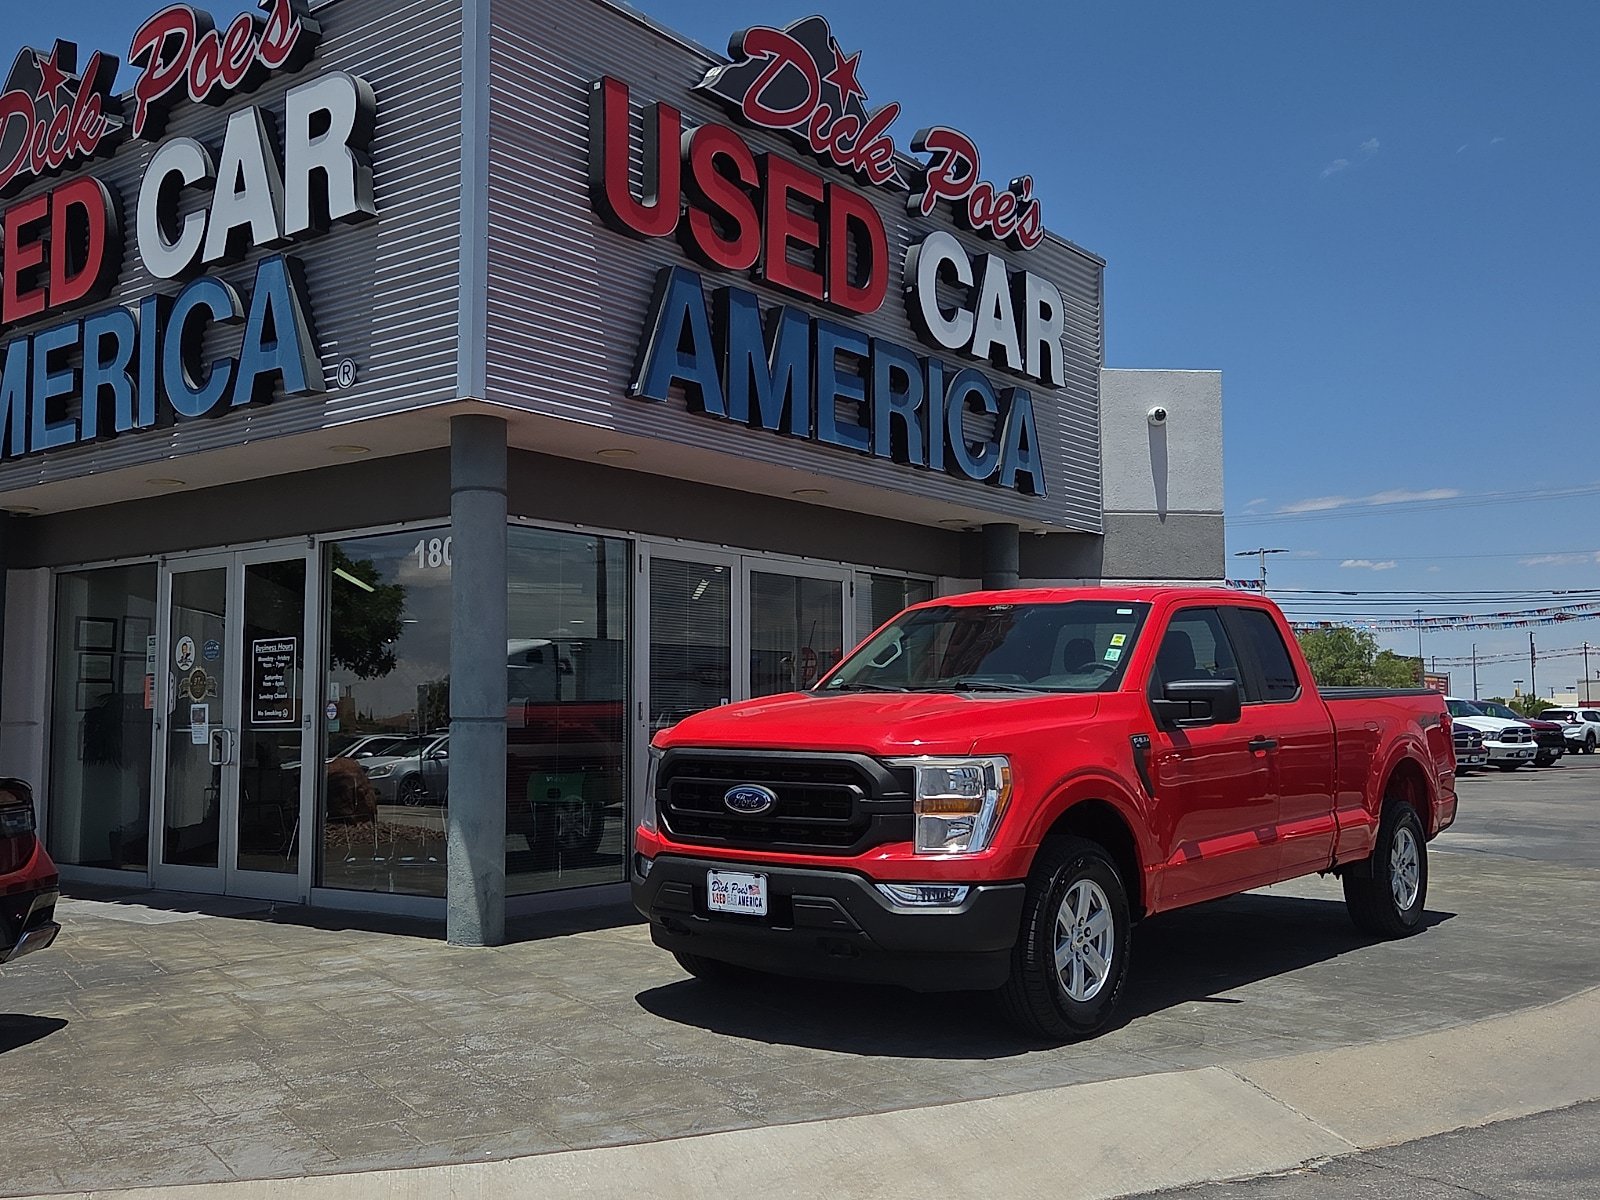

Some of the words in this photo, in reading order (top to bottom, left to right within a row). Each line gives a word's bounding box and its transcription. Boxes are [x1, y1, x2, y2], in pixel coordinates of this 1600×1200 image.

[129, 0, 302, 139] Poes
[742, 25, 901, 186] Dick
[924, 126, 1045, 252] Poe's
[136, 70, 368, 280] CAR
[602, 75, 889, 315] USED
[917, 230, 1066, 388] CAR
[638, 265, 1048, 499] AMERICA
[256, 644, 277, 653] Business
[278, 643, 294, 652] Hours
[733, 792, 760, 809] Ford
[711, 880, 729, 893] Dick
[731, 882, 748, 895] Poe's
[712, 892, 726, 905] USED
[738, 895, 763, 908] AMERICA
